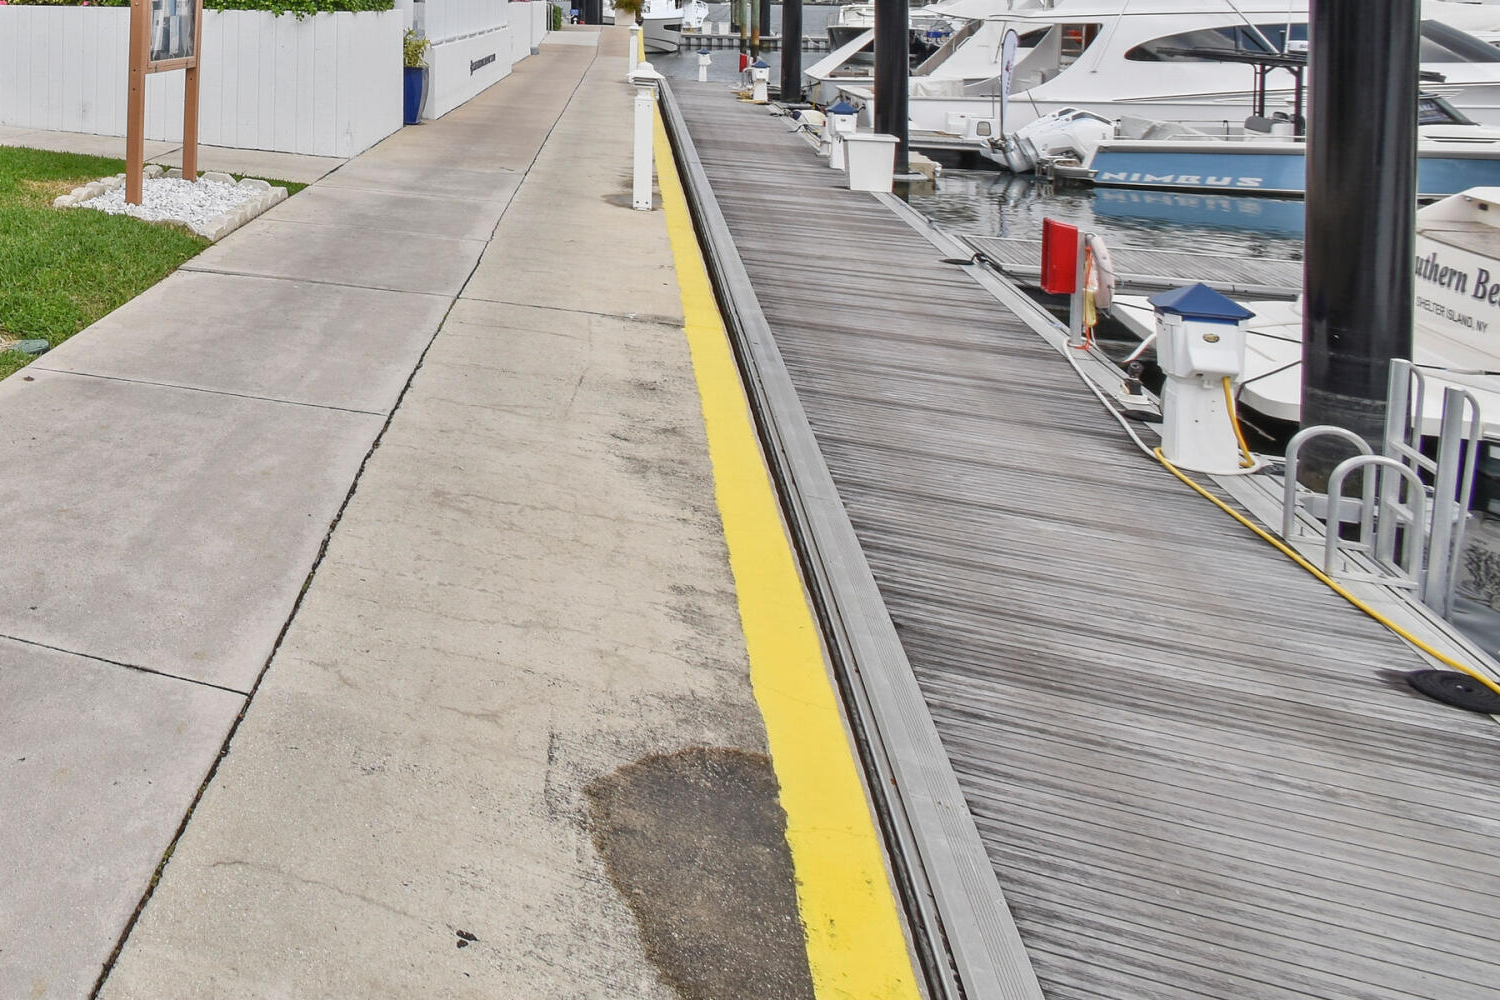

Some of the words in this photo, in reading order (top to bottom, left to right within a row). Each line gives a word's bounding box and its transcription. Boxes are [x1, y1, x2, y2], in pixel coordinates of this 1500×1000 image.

[1102, 171, 1264, 188] NIMBUS
[1414, 252, 1469, 294] uthern
[1471, 267, 1500, 308] Be
[1415, 296, 1446, 318] SHELTER
[1476, 319, 1489, 333] NY
